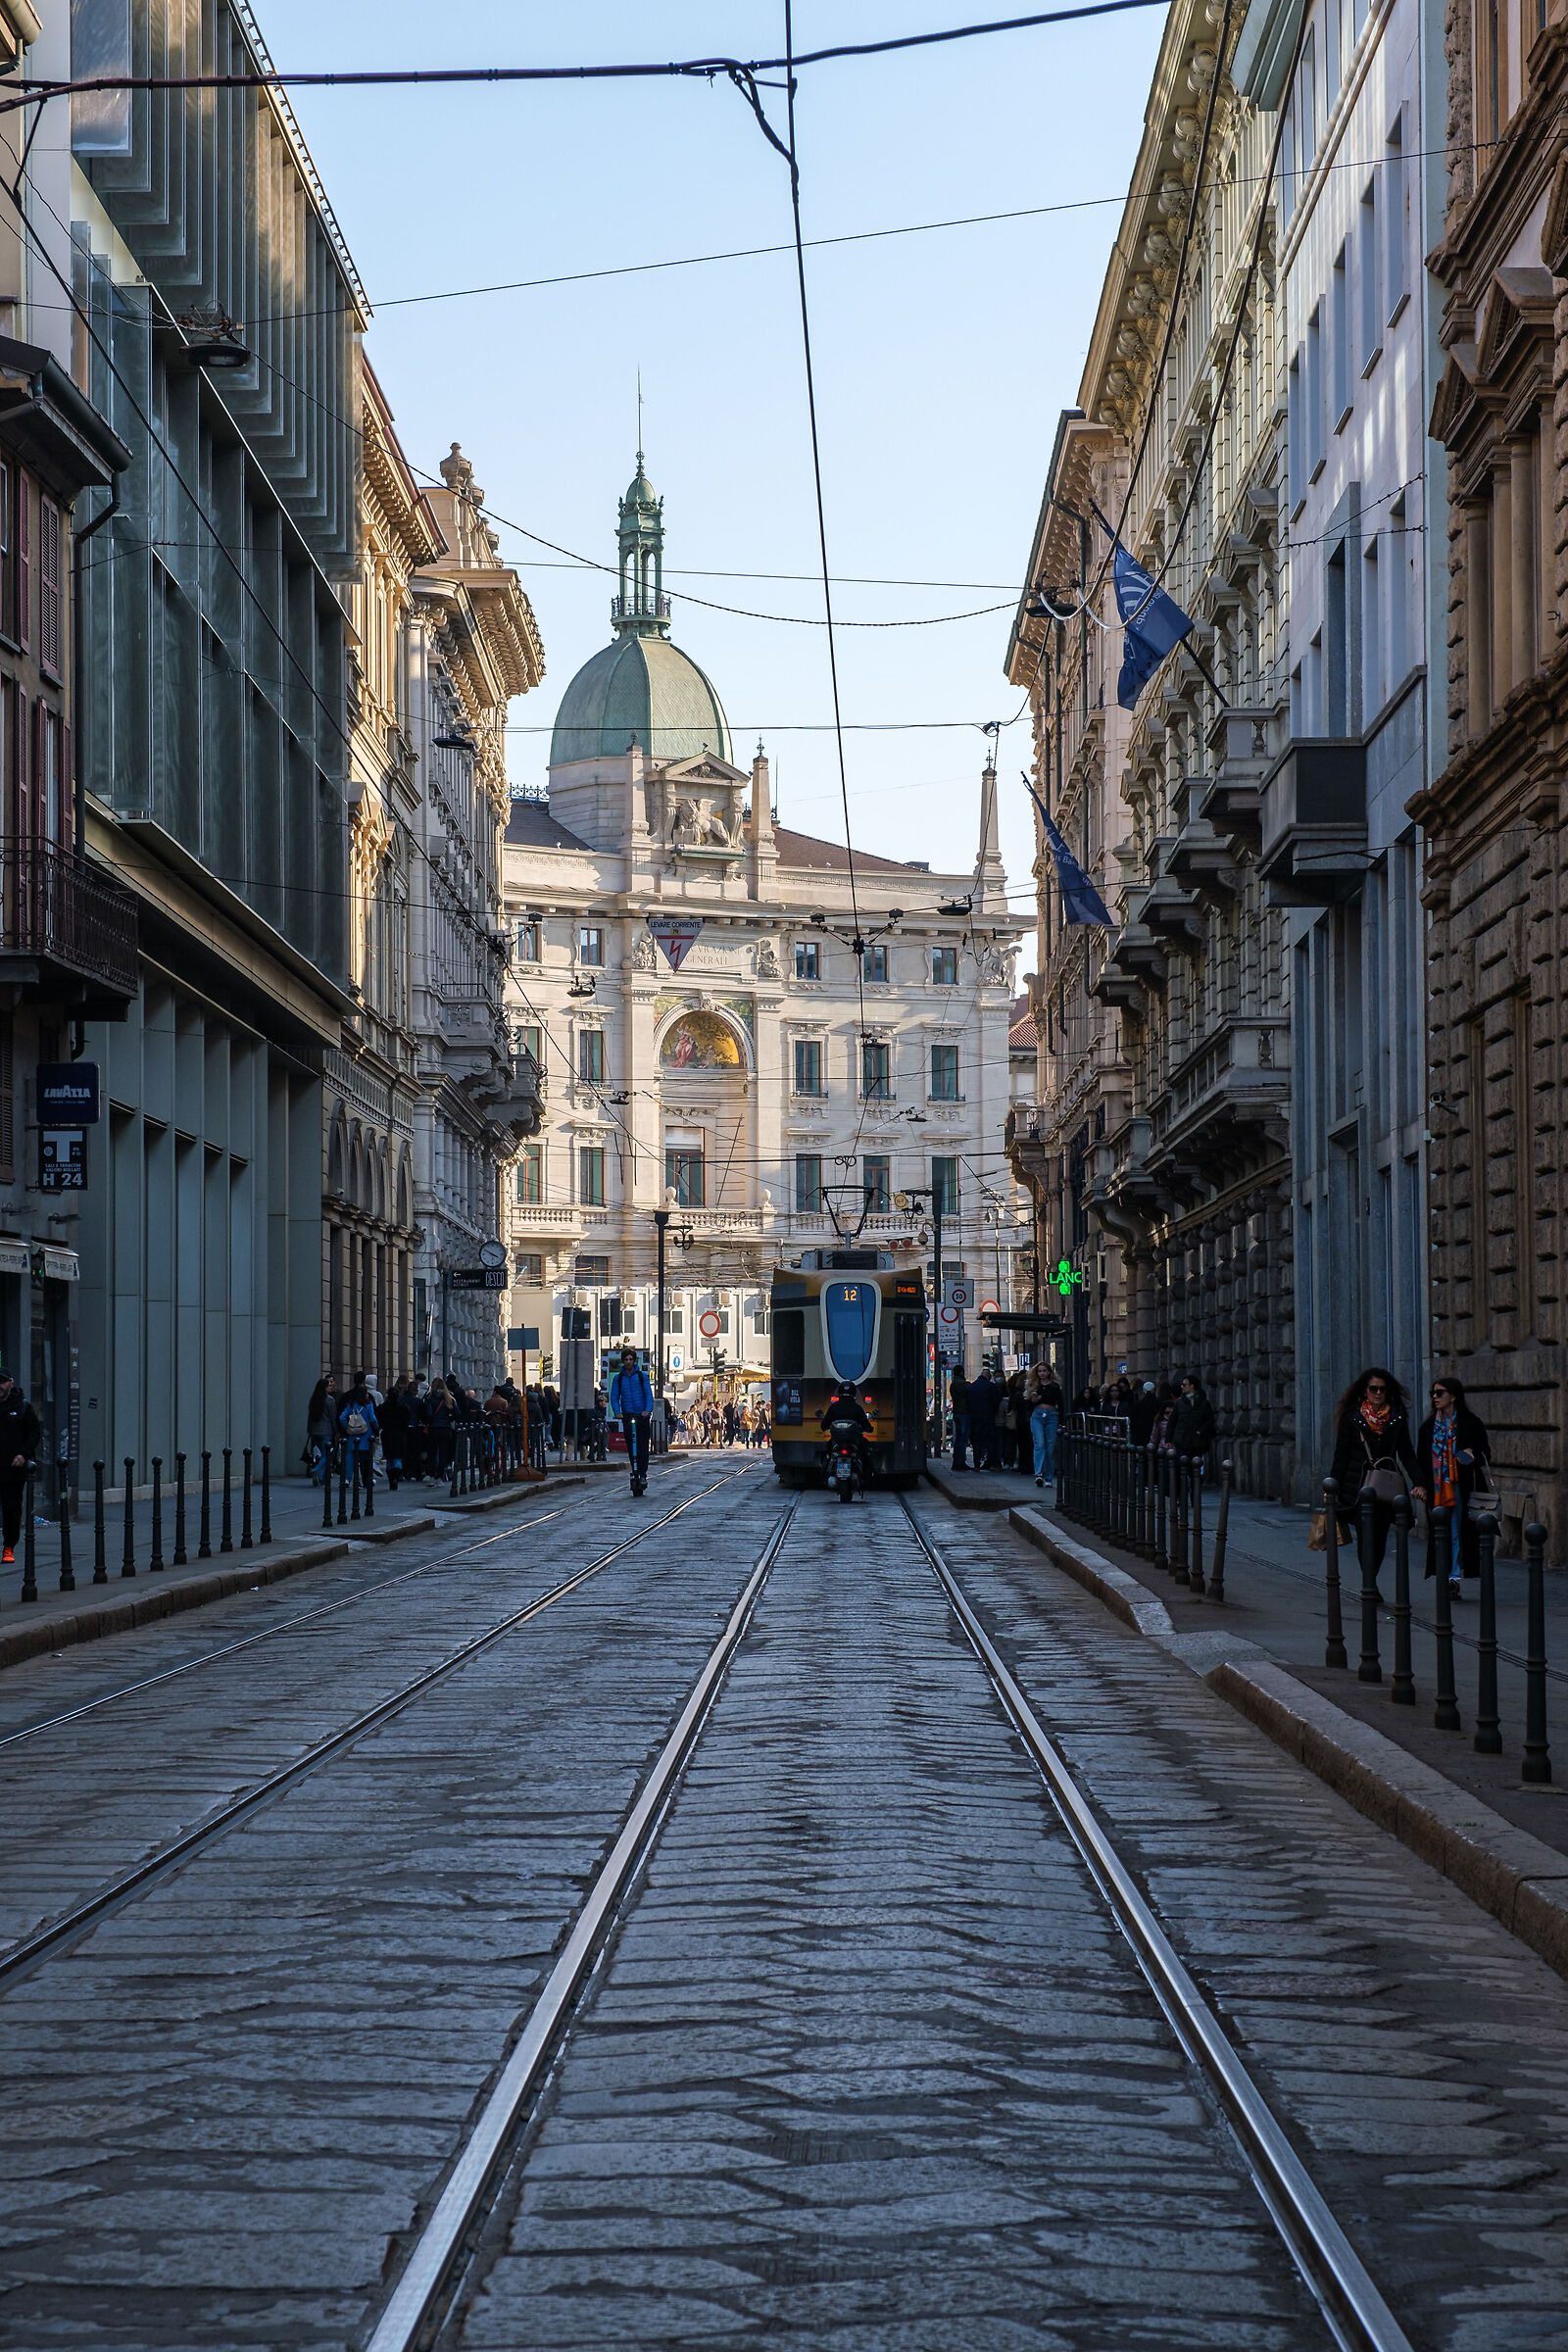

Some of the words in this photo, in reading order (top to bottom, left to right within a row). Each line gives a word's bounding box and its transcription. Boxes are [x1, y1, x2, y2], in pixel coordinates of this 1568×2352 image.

[44, 1085, 91, 1099] LAVAZZA
[43, 1131, 83, 1163] T
[43, 1173, 55, 1186] H
[61, 1173, 83, 1186] 24
[845, 1290, 858, 1301] 12
